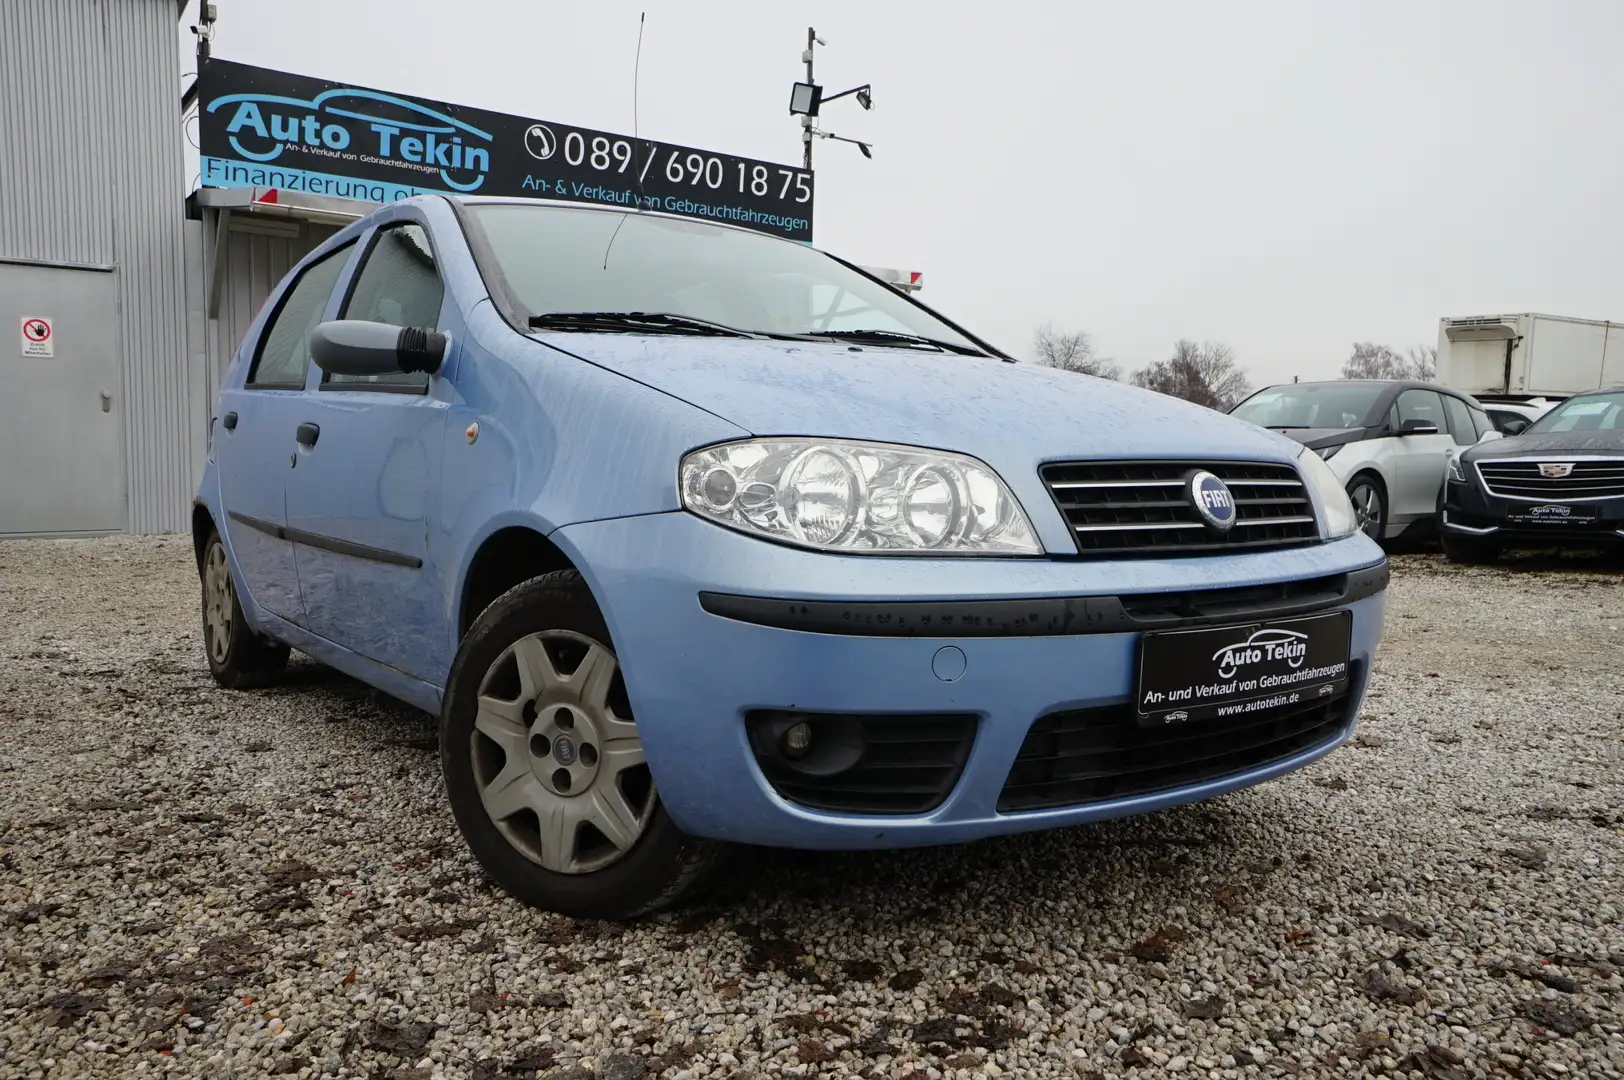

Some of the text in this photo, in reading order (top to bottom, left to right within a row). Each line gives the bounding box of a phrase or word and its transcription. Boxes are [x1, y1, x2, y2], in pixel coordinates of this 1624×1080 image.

[226, 102, 490, 172] Auto Tekin
[310, 146, 341, 159] Verkauf
[341, 152, 357, 161] von
[360, 154, 440, 173] Gebrauchtfahrzeugen
[564, 132, 632, 173] 089
[665, 151, 724, 189] 690
[737, 163, 768, 196] 18
[778, 169, 811, 203] 75
[522, 174, 551, 192] An-
[555, 179, 567, 195] &
[572, 181, 631, 205] Verkauf
[664, 196, 808, 231] Gebrauchtfahrzeugen
[1202, 490, 1230, 508] FIAT
[1221, 640, 1306, 667] Auto Tekin
[1144, 662, 1345, 704] An- und Verkauf von Gebrauchtfahrzeugen
[1217, 693, 1299, 716] www.autotekin.de
